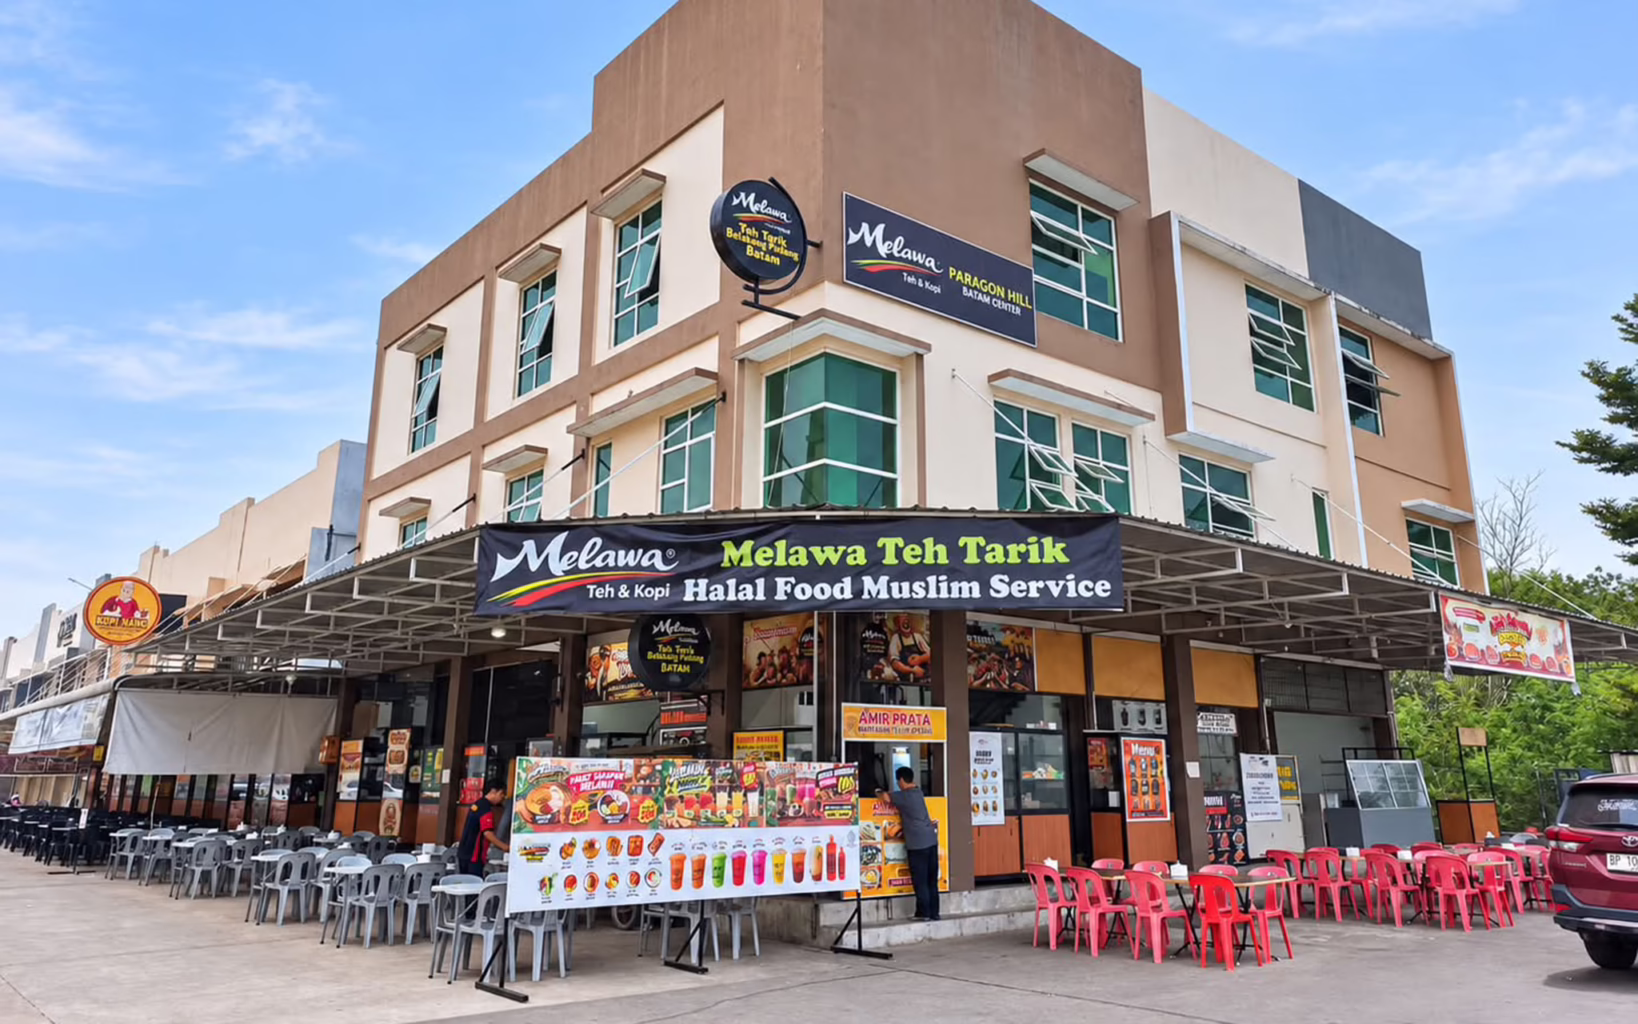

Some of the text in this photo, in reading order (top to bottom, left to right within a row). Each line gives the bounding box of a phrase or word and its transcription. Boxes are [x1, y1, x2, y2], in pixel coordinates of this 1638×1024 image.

[731, 191, 792, 223] Melawa
[739, 222, 758, 239] Teh
[761, 230, 787, 248] Tarik
[847, 222, 944, 274] Melawa
[746, 245, 780, 265] Batam
[903, 272, 942, 294] Teh & Kopi
[949, 267, 1032, 309] PARAGON HILL
[962, 286, 1021, 316] BATAM CENTER
[490, 530, 679, 583] Melawa
[721, 536, 1070, 568] Melawa Teh Tarik
[587, 584, 671, 600] Teh & Kopi
[683, 573, 1112, 602] Halal Food Muslim Service
[859, 711, 931, 726] AMIR PRATA
[1131, 743, 1155, 756] Menu
[1609, 855, 1621, 866] BP
